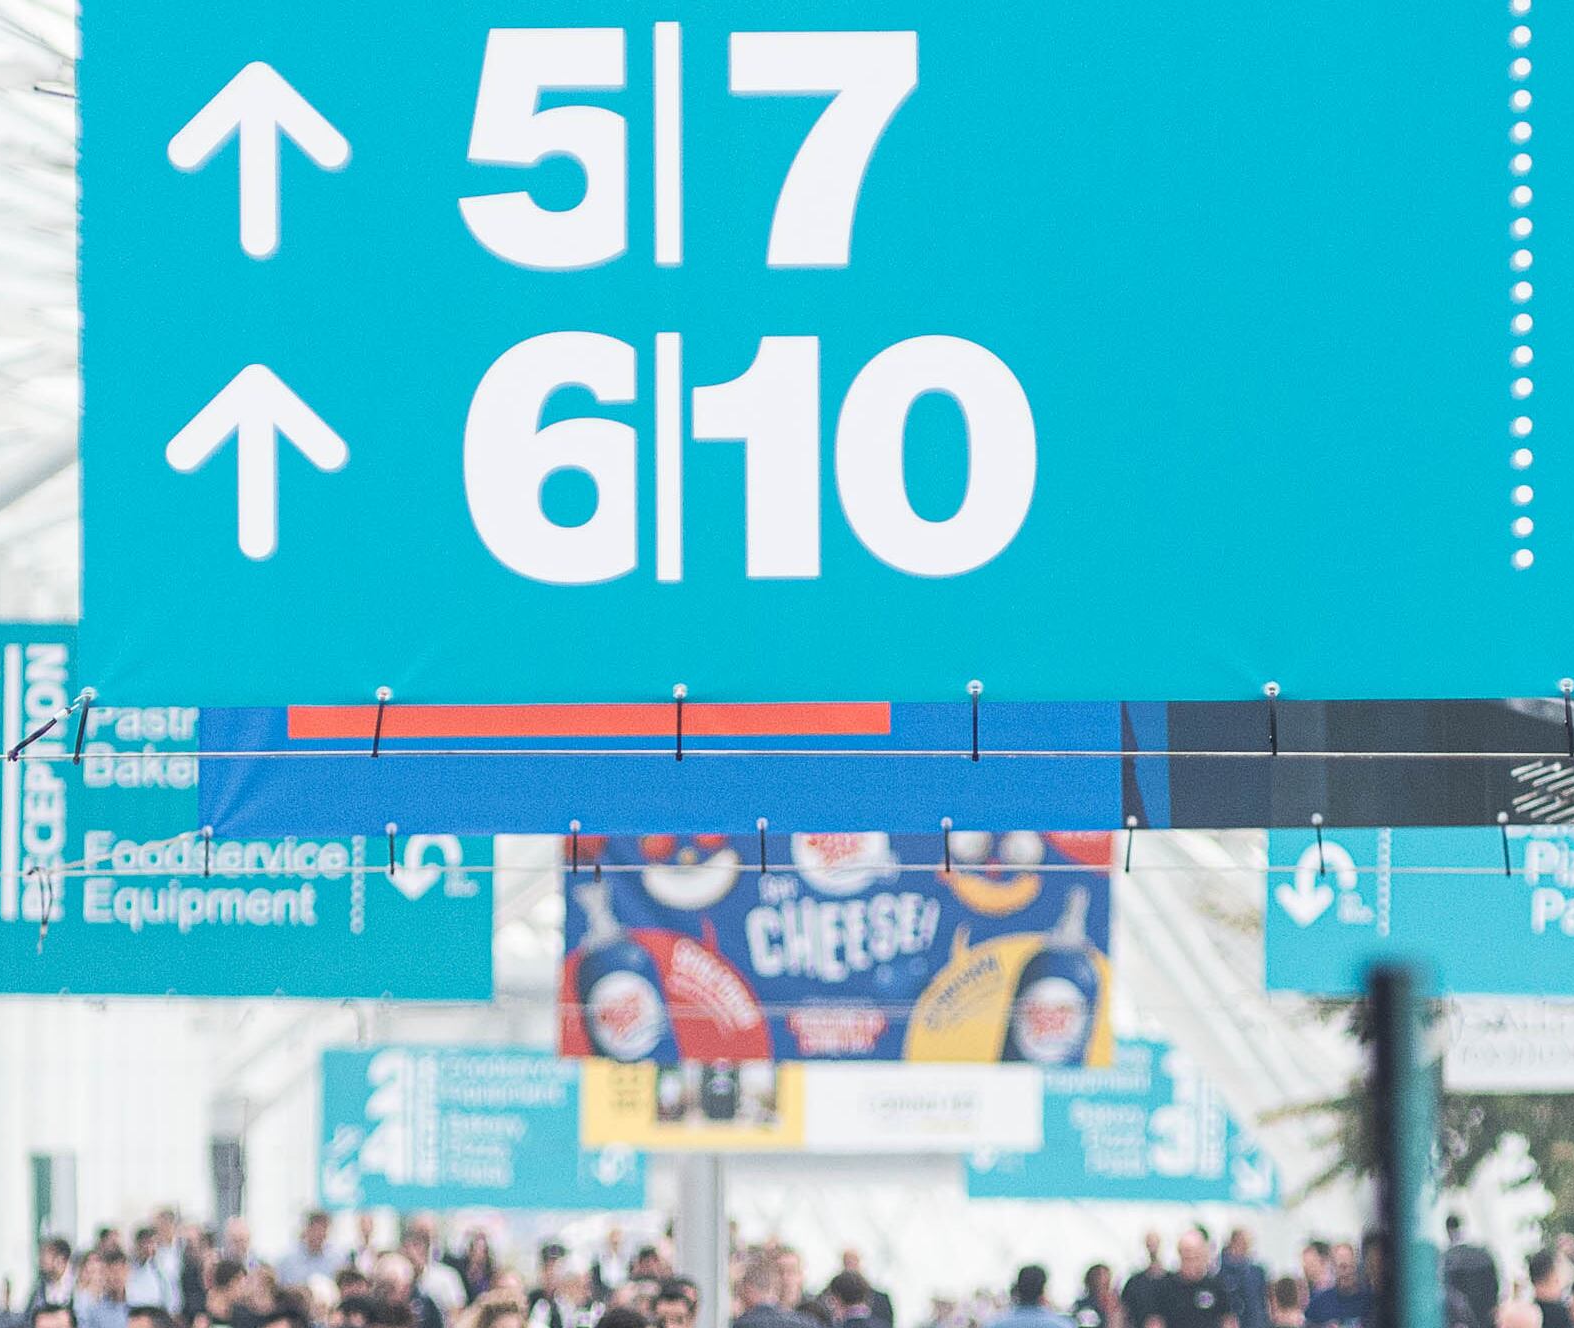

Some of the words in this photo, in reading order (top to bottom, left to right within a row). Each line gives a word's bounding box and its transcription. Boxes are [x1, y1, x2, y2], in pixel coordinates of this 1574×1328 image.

[85, 707, 199, 741] Pastr
[84, 742, 199, 788] Bake
[84, 830, 350, 879] Foodservice
[83, 877, 318, 933] Equipment
